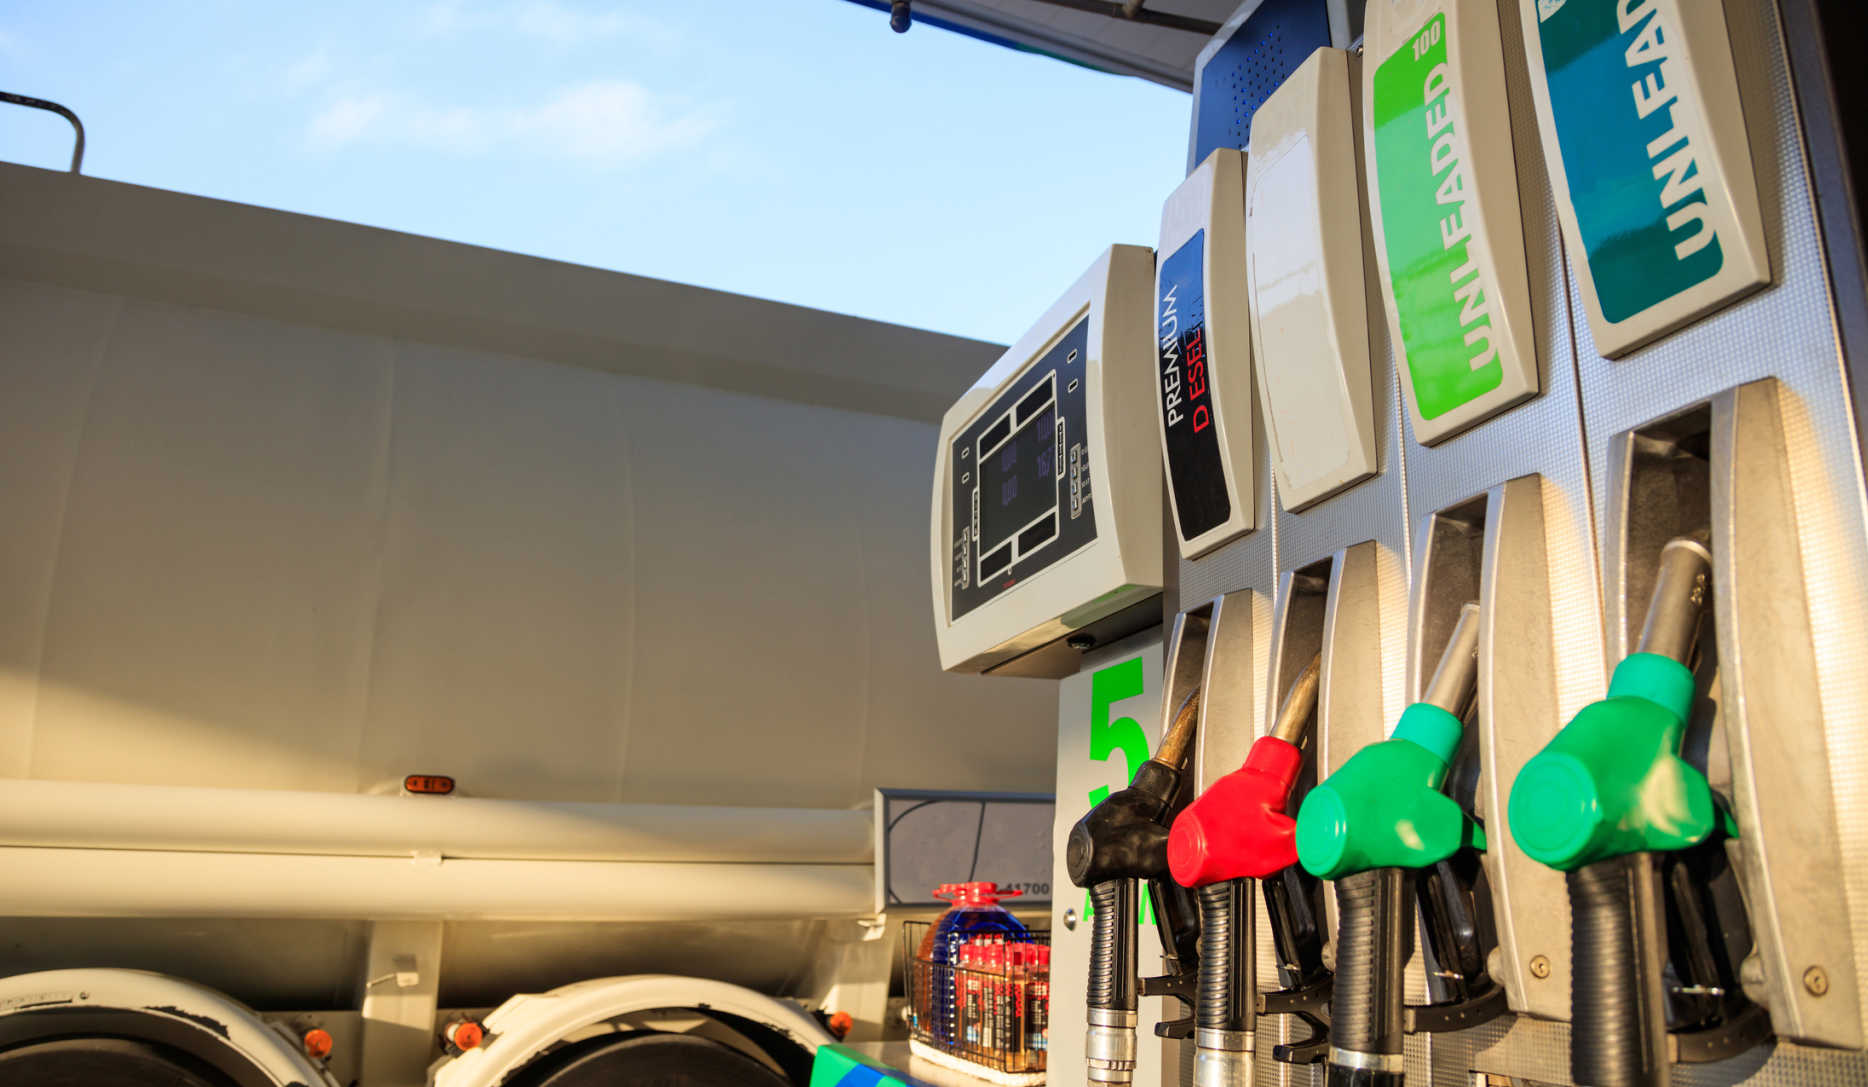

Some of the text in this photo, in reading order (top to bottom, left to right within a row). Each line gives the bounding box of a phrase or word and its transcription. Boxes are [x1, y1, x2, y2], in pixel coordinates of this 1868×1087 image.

[1412, 20, 1441, 62] 100
[1424, 62, 1496, 372] UNLEADED
[1162, 284, 1184, 427] PREMIUM
[1089, 656, 1150, 808] 5
